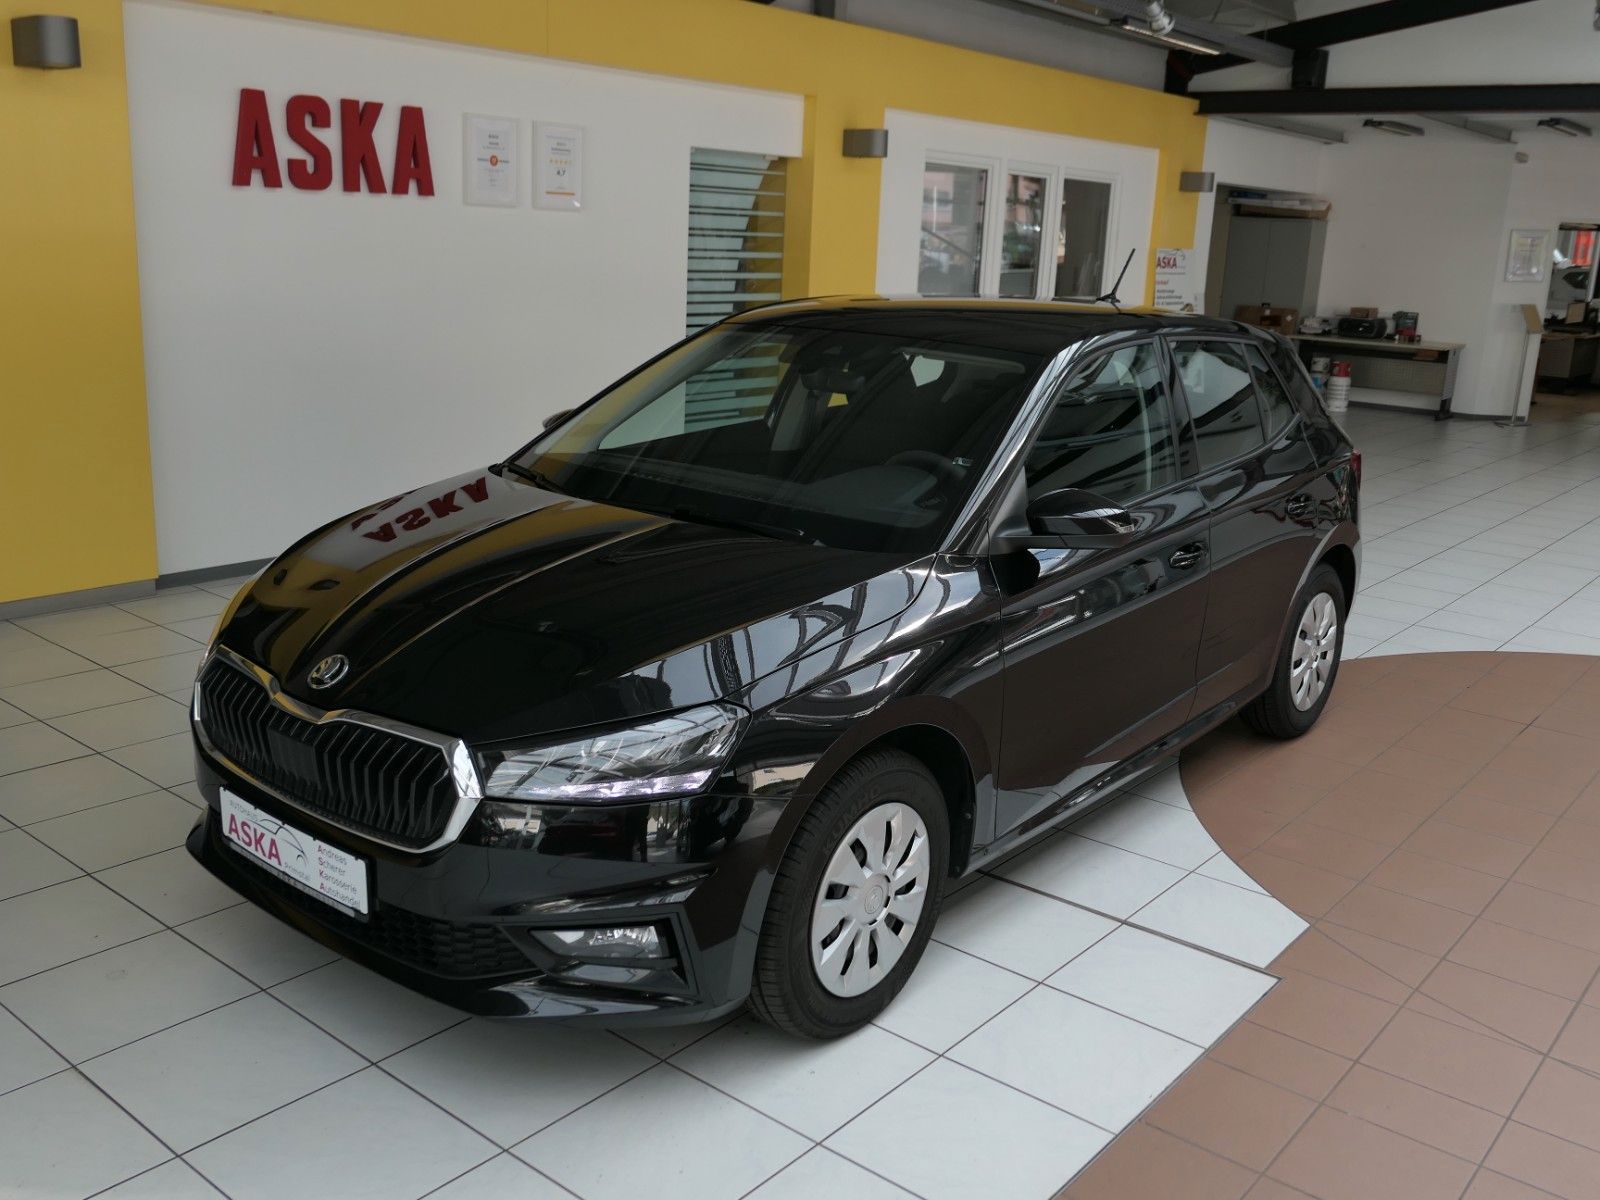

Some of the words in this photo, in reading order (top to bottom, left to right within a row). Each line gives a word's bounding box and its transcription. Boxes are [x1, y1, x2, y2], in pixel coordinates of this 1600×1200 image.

[232, 87, 435, 196] ASKA
[1156, 256, 1177, 269] ASKA
[228, 813, 282, 866] ASKA
[318, 845, 347, 866] Andreas
